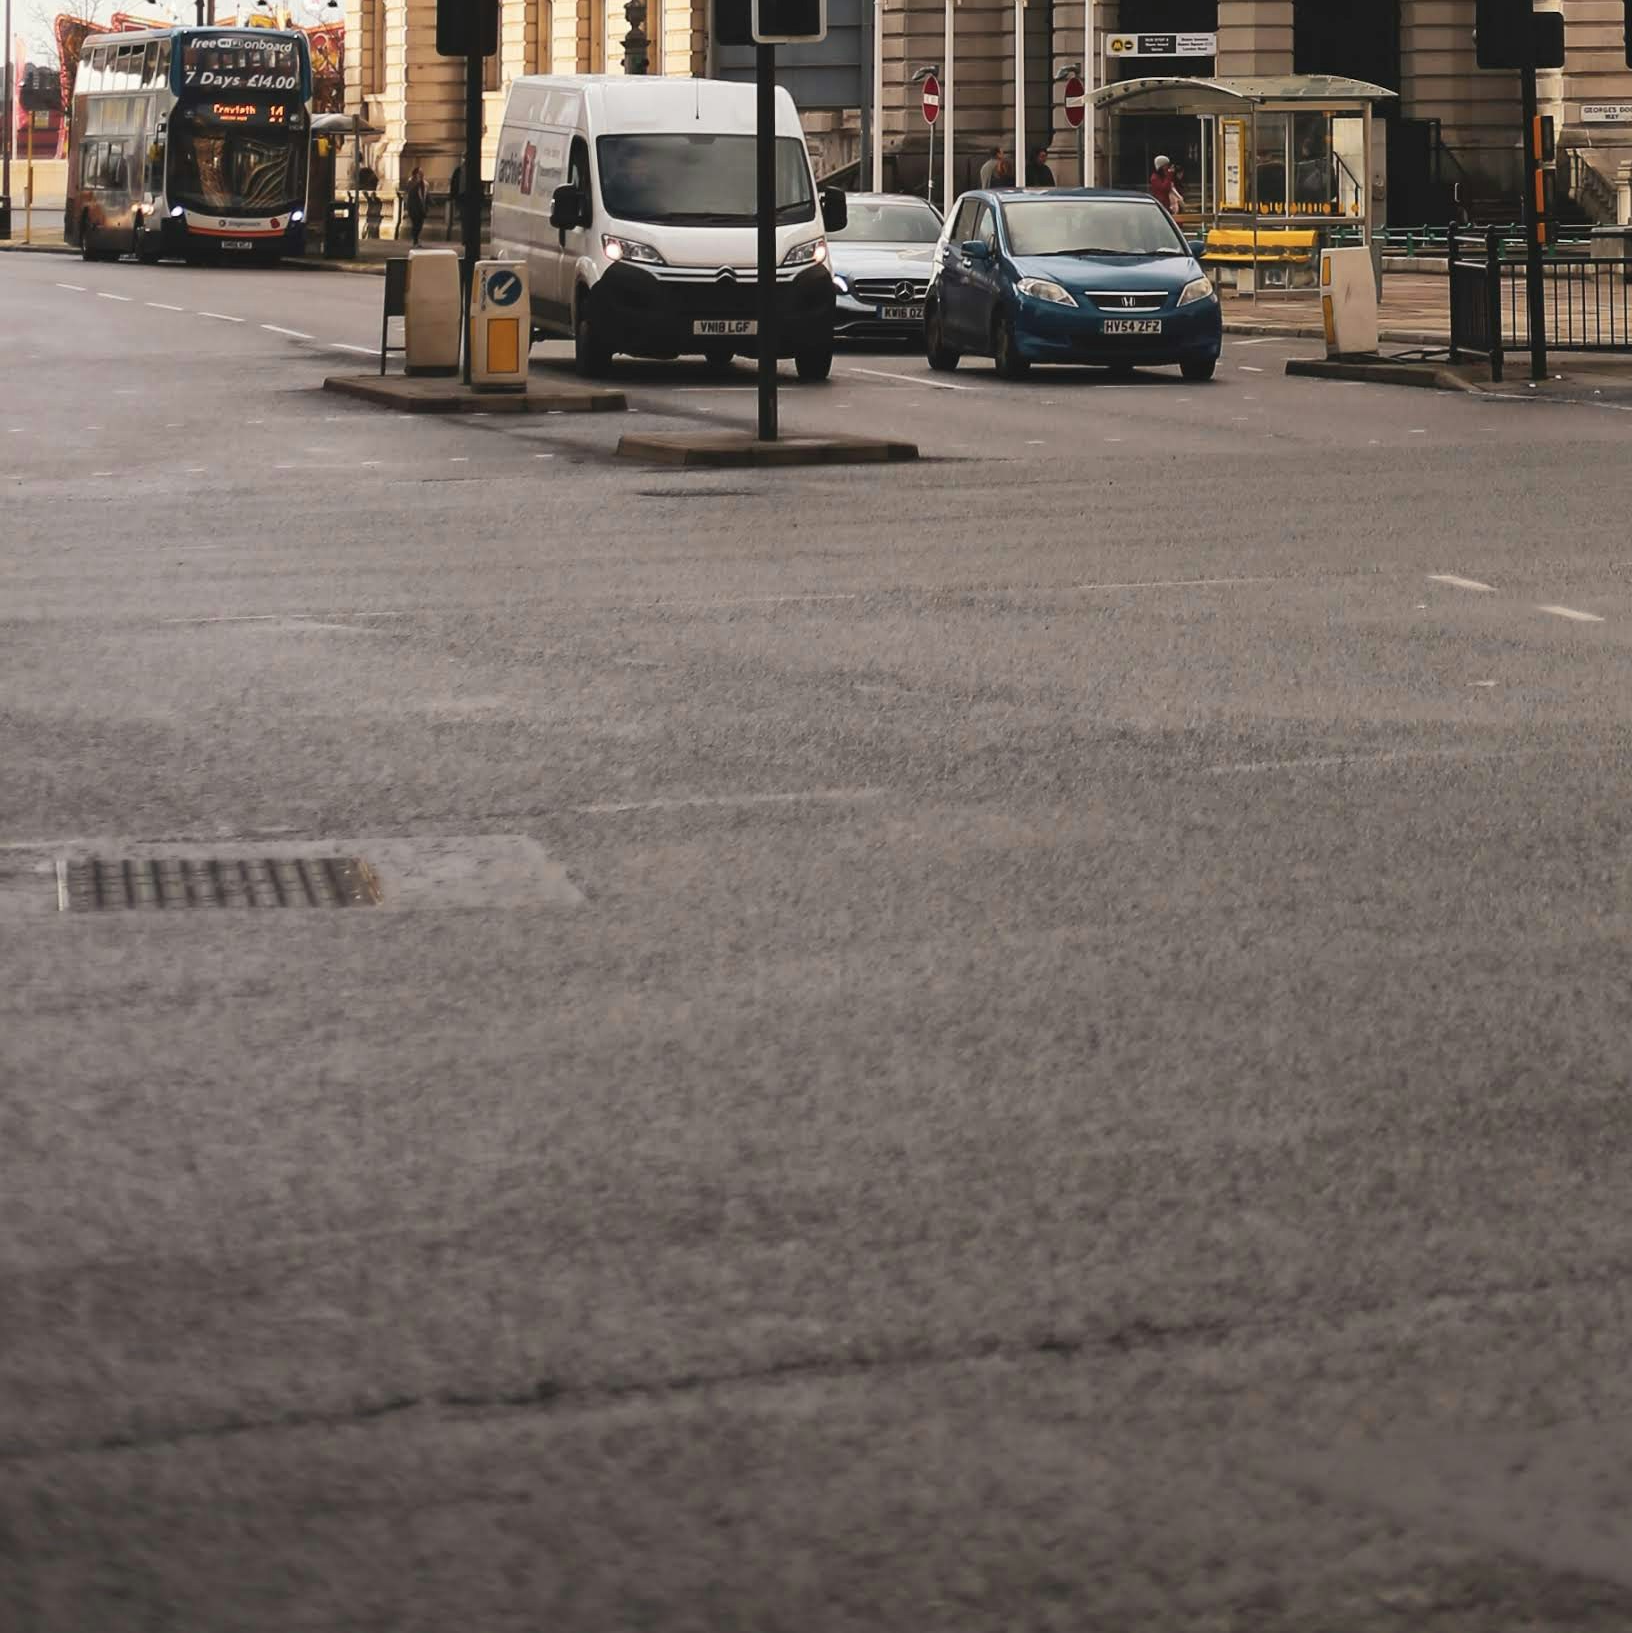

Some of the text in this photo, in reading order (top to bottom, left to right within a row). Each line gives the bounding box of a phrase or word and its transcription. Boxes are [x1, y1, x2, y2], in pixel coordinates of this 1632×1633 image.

[190, 38, 217, 49] free
[244, 40, 293, 53] onboard
[185, 72, 296, 89] 7 Days £14.00
[728, 322, 751, 333] LGF
[1106, 321, 1160, 332] HV54 ZFZ
